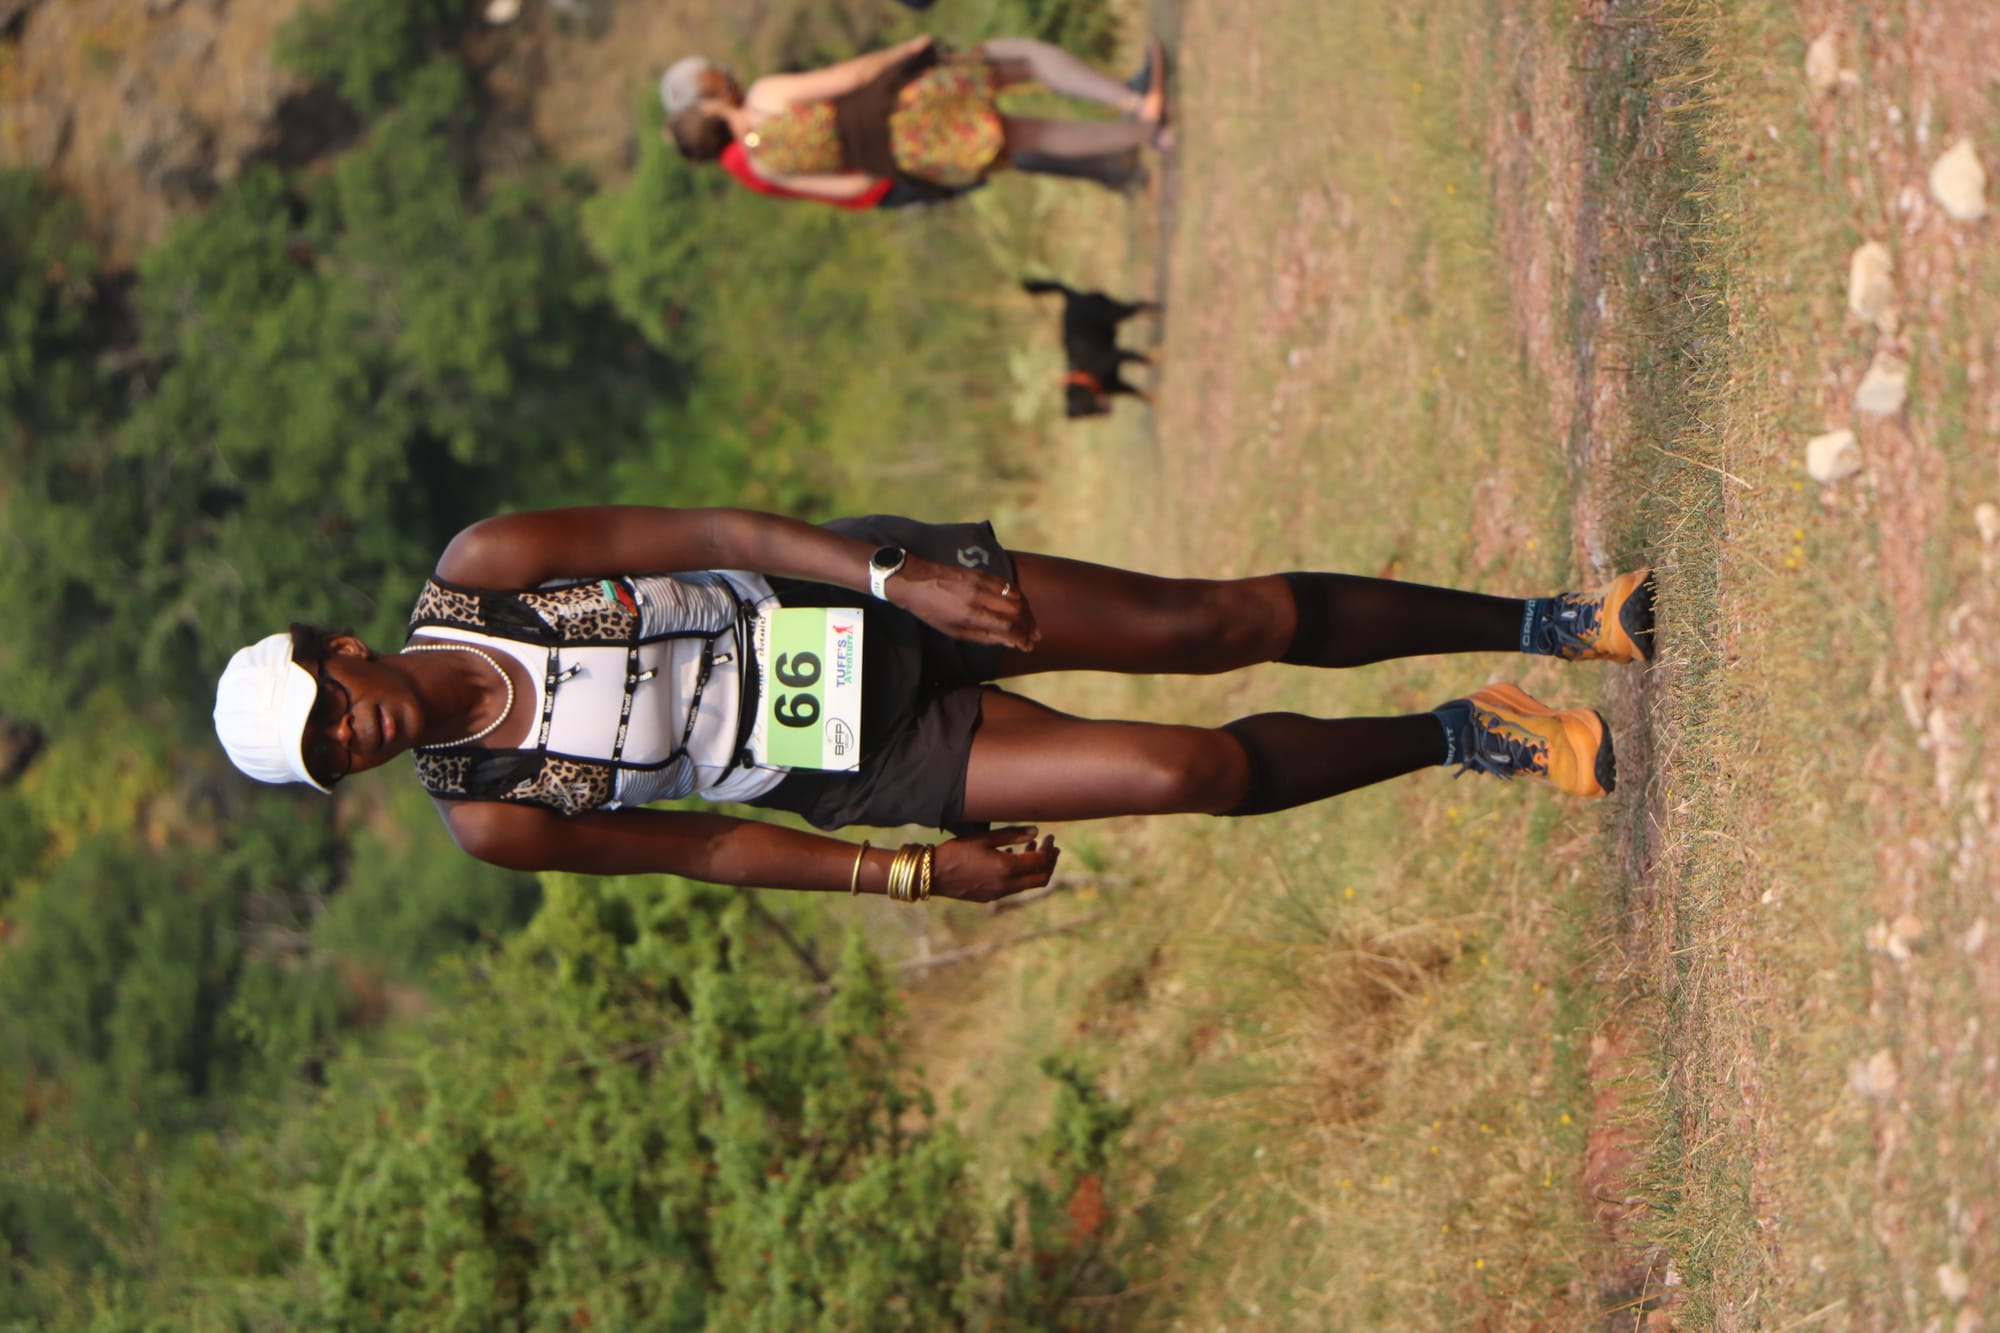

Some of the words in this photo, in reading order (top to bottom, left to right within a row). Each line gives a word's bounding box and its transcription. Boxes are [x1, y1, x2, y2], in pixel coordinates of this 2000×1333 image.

[836, 639, 847, 688] TUFF'S
[844, 634, 854, 684] Aventure
[774, 651, 821, 729] 66
[835, 723, 845, 756] BFP
